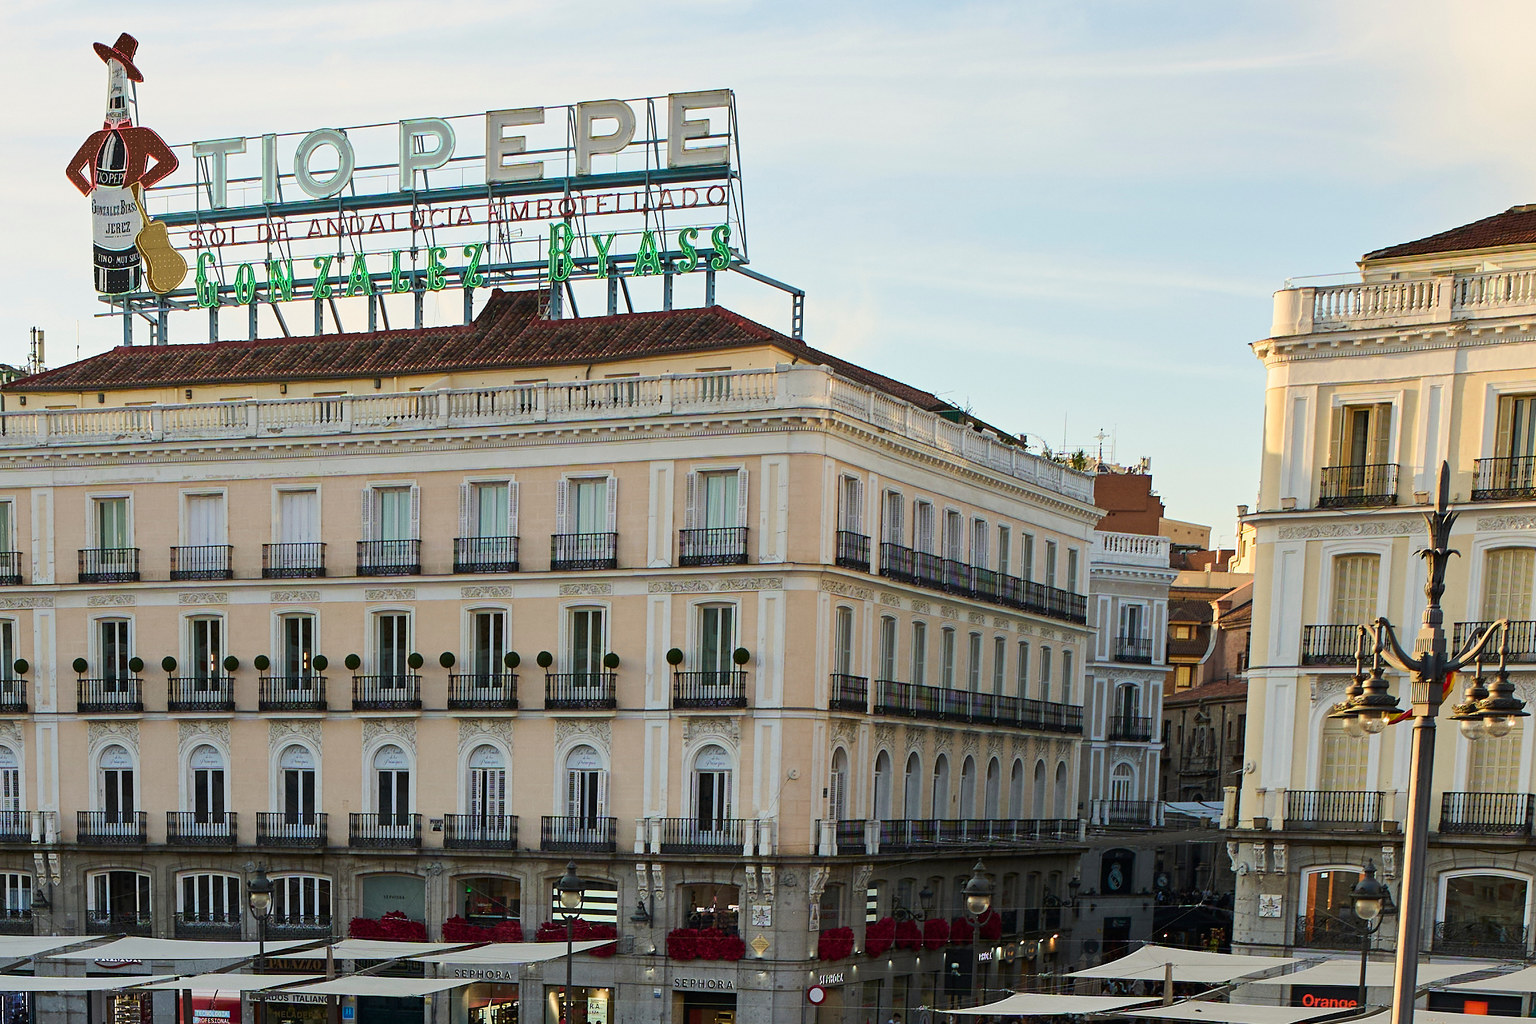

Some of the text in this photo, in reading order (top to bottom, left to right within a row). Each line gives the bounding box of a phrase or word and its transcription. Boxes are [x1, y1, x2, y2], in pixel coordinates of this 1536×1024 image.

[192, 89, 730, 208] TIO PEPE
[110, 171, 124, 183] PEP
[189, 185, 727, 250] SOL DE ANDALUCIA EMBOTELLADO
[105, 221, 131, 235] JEREZ
[195, 222, 732, 308] GONZALEZ BYASS
[269, 958, 323, 970] PALAZZO
[454, 969, 512, 981] SEPHORA
[674, 978, 734, 990] SEPHORA
[1302, 993, 1358, 1008] Orange
